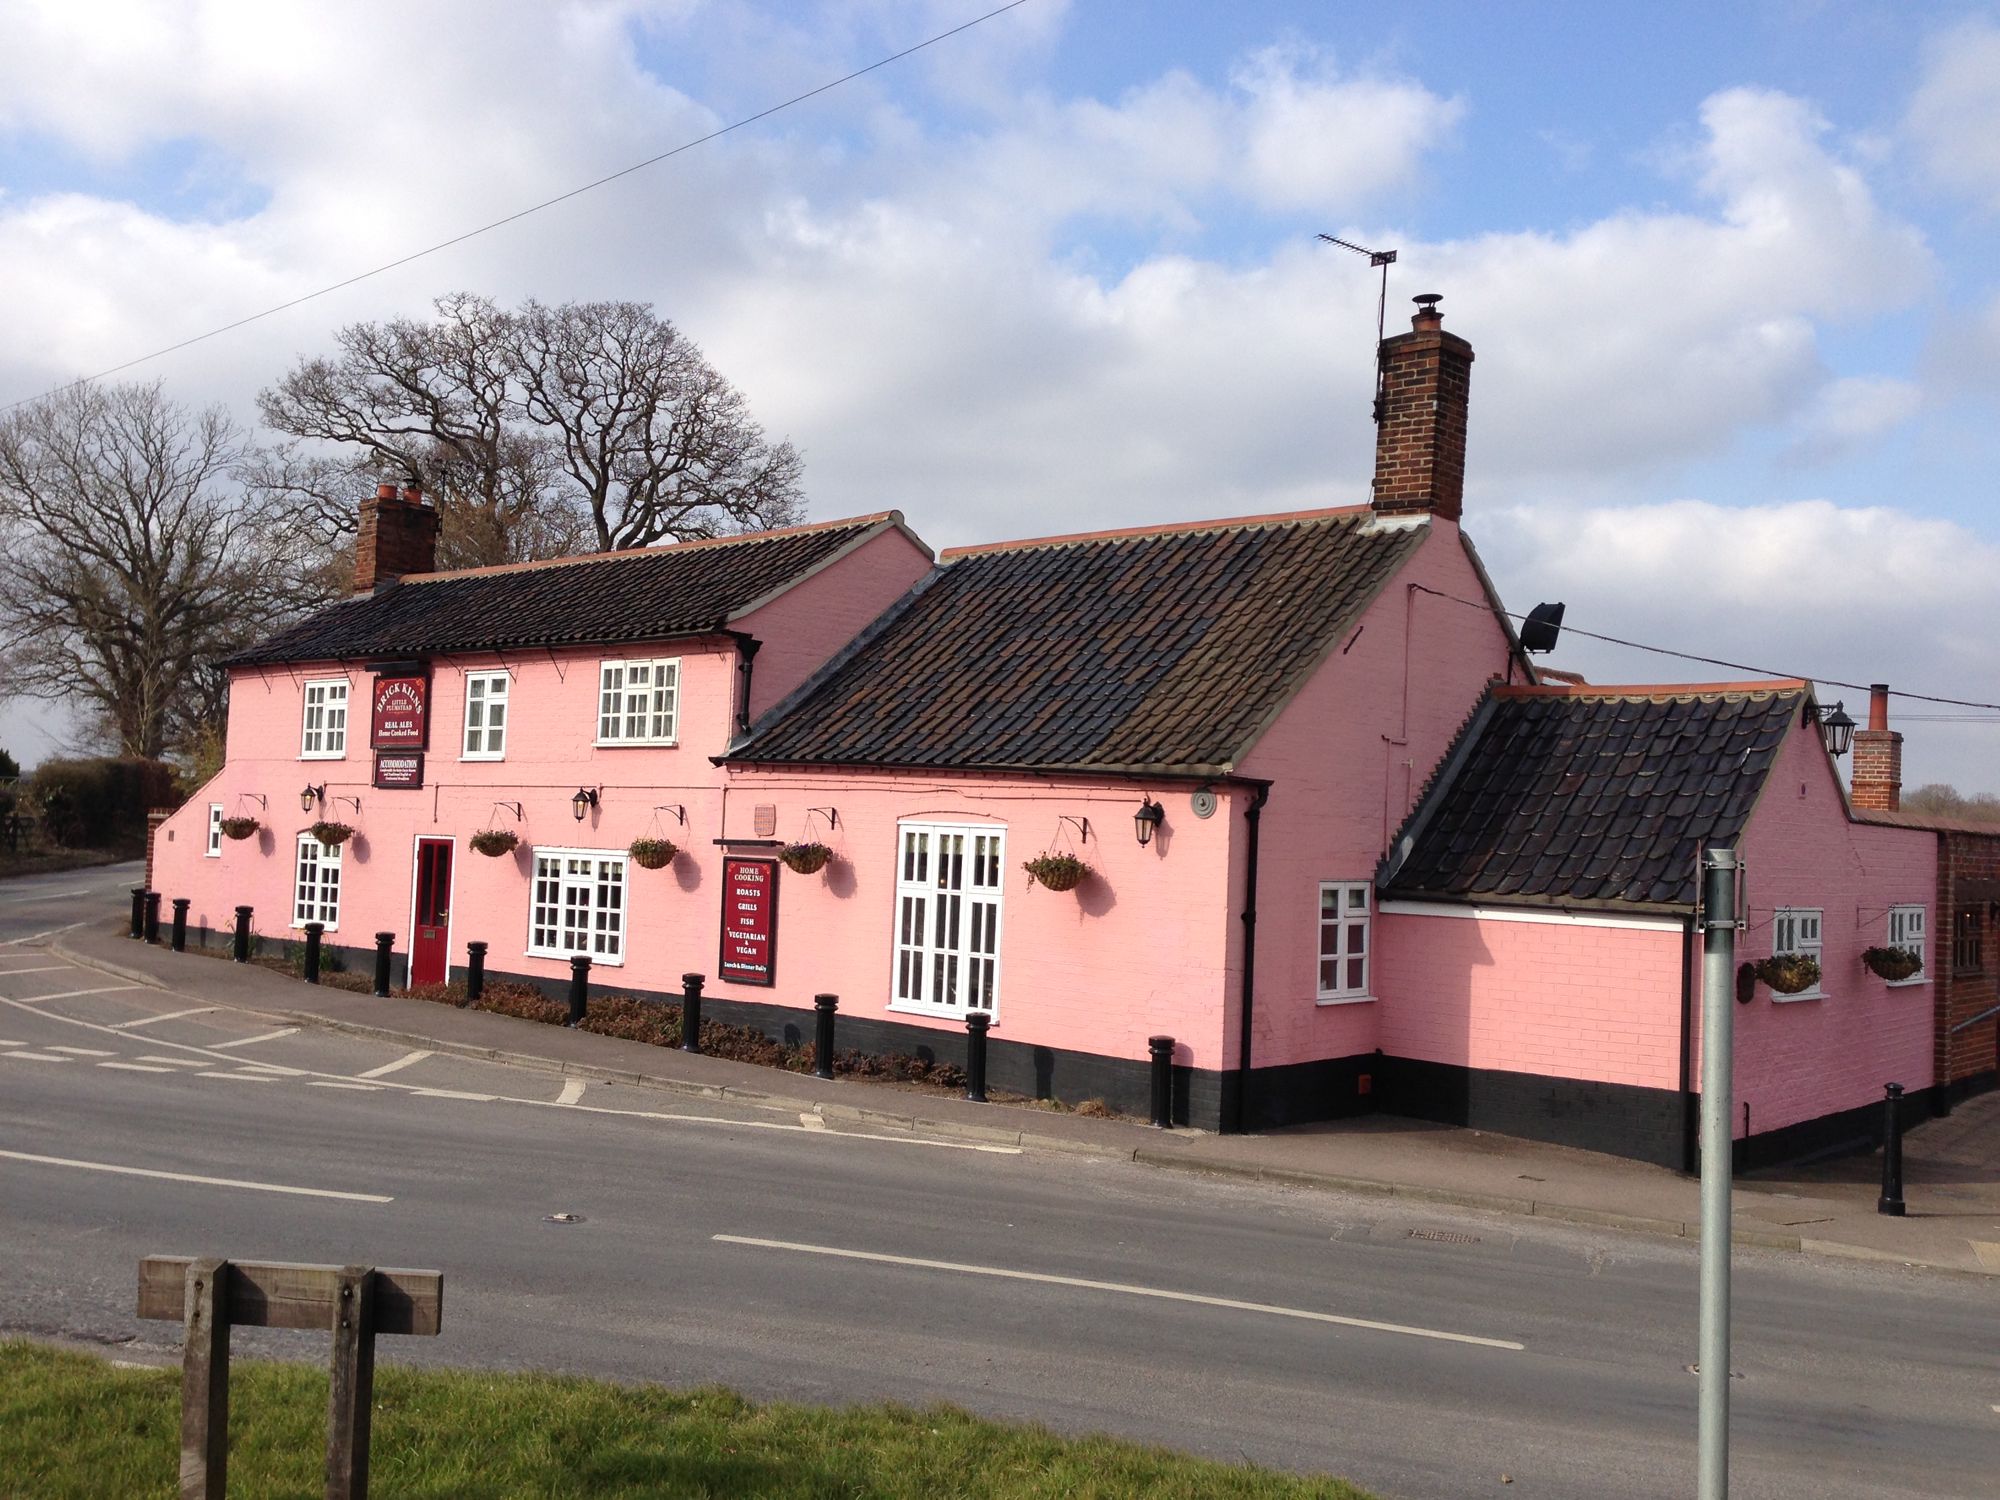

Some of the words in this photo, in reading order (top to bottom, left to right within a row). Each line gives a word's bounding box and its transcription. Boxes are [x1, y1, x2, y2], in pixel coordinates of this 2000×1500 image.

[377, 683, 400, 713] BRICK
[402, 683, 422, 714] KILNS
[385, 721, 398, 729] REAL
[740, 867, 759, 875] HOME
[734, 874, 764, 882] COOKING
[736, 888, 760, 897] ROASTS
[738, 903, 757, 911] GRILLS
[729, 931, 766, 941] VEGETARIAN
[736, 946, 757, 955] VEGAN
